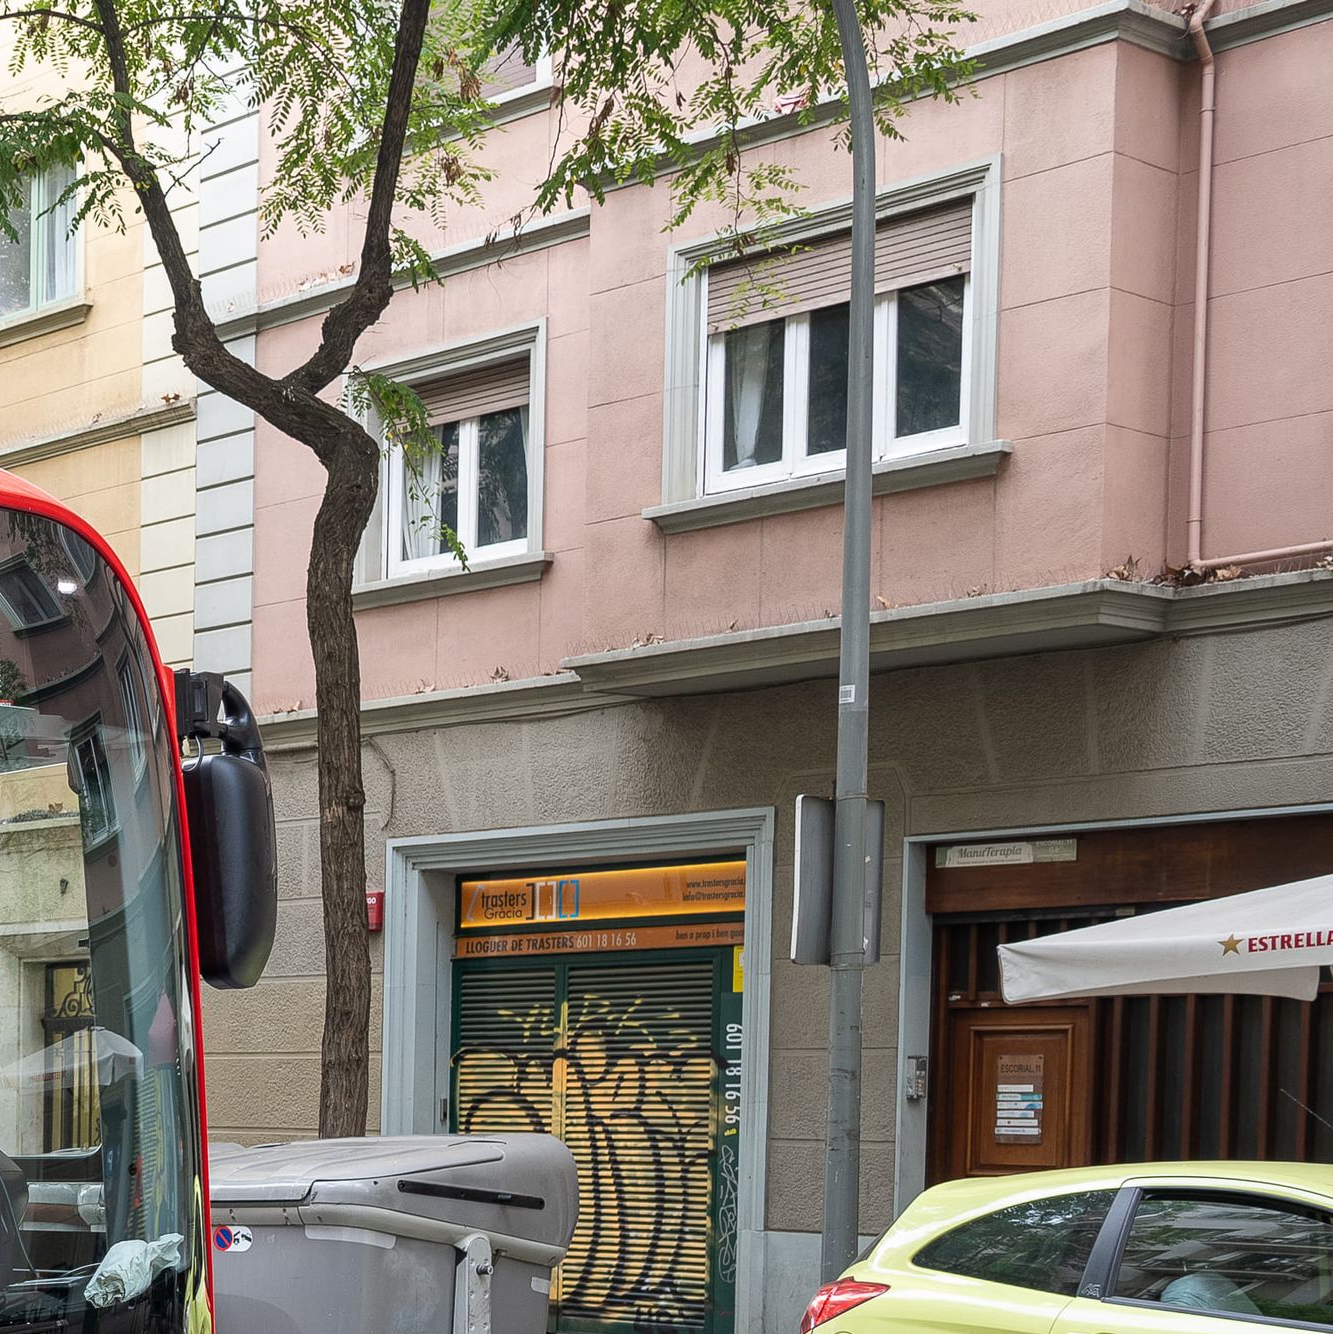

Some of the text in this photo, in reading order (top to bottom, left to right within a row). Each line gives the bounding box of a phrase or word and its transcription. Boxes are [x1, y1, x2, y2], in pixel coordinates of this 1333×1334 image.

[481, 891, 527, 909] trasters
[465, 931, 637, 954] LLOGUER DE TRASTERS 601 18 16 56
